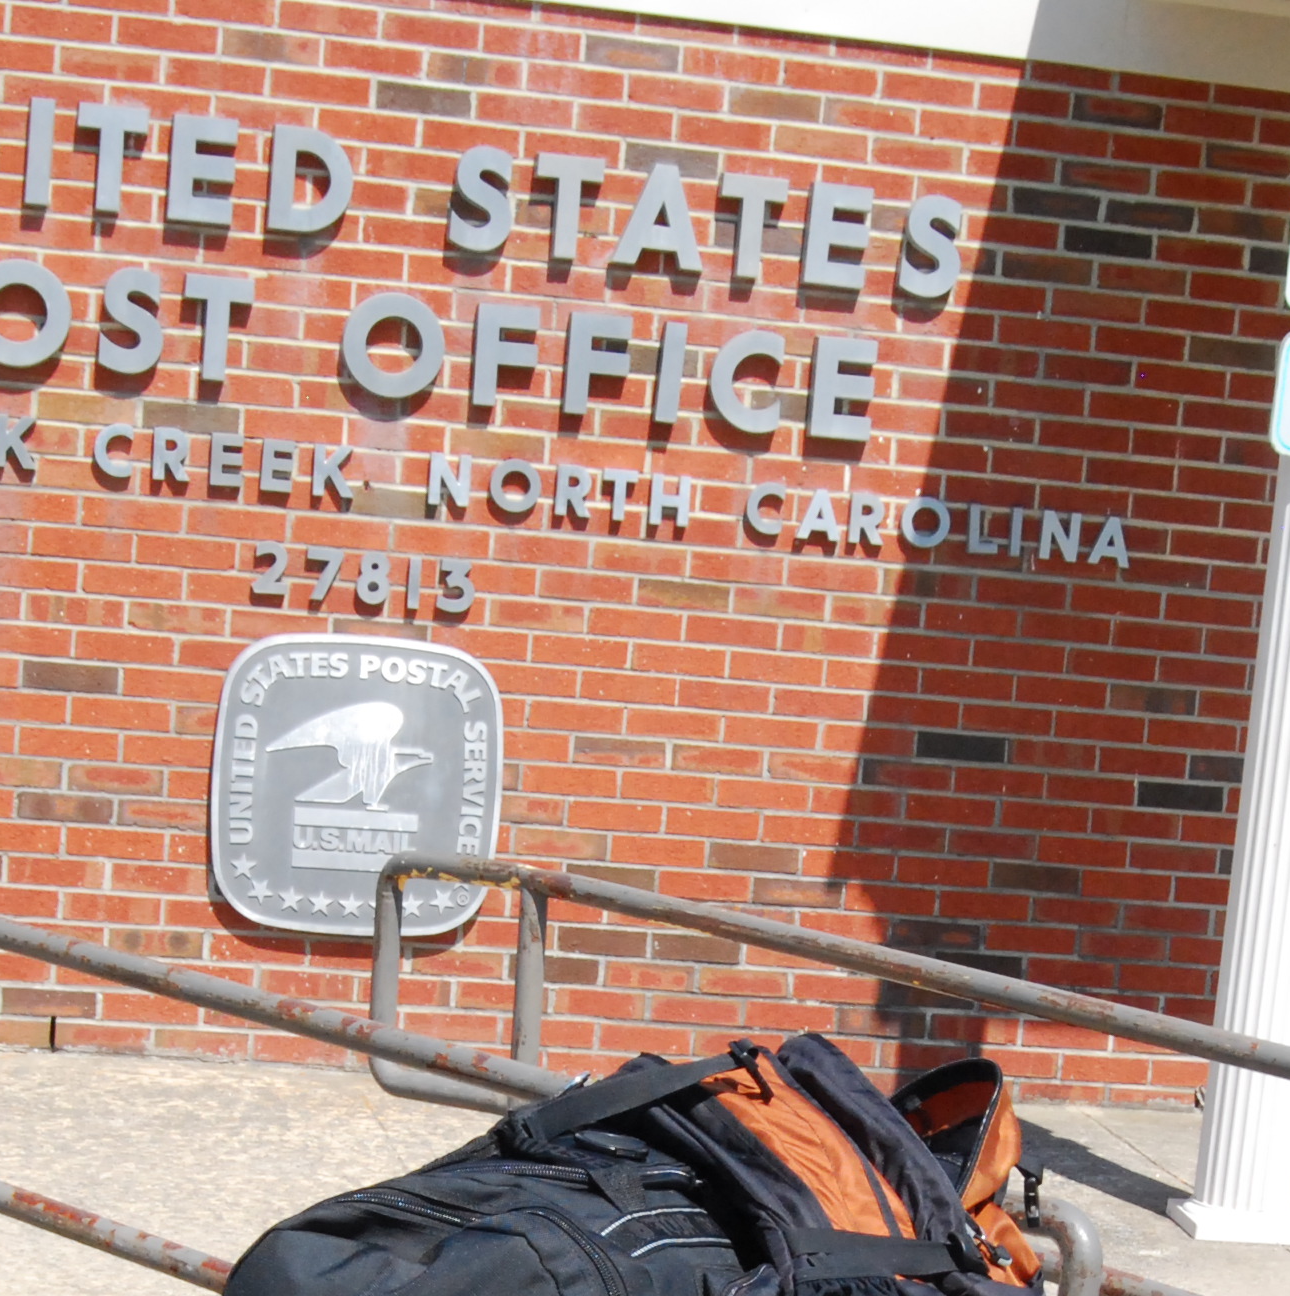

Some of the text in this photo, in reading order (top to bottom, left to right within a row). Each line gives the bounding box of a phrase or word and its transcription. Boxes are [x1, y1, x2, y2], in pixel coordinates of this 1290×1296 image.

[446, 145, 963, 300] STATES
[342, 291, 880, 443] OFFICE
[93, 423, 353, 500] CREEK
[427, 451, 692, 530] NORTH
[745, 481, 1130, 569] CAROLINA
[251, 541, 476, 613] 27813
[229, 652, 488, 857] UNITED STATES POSTAL SERVICE
